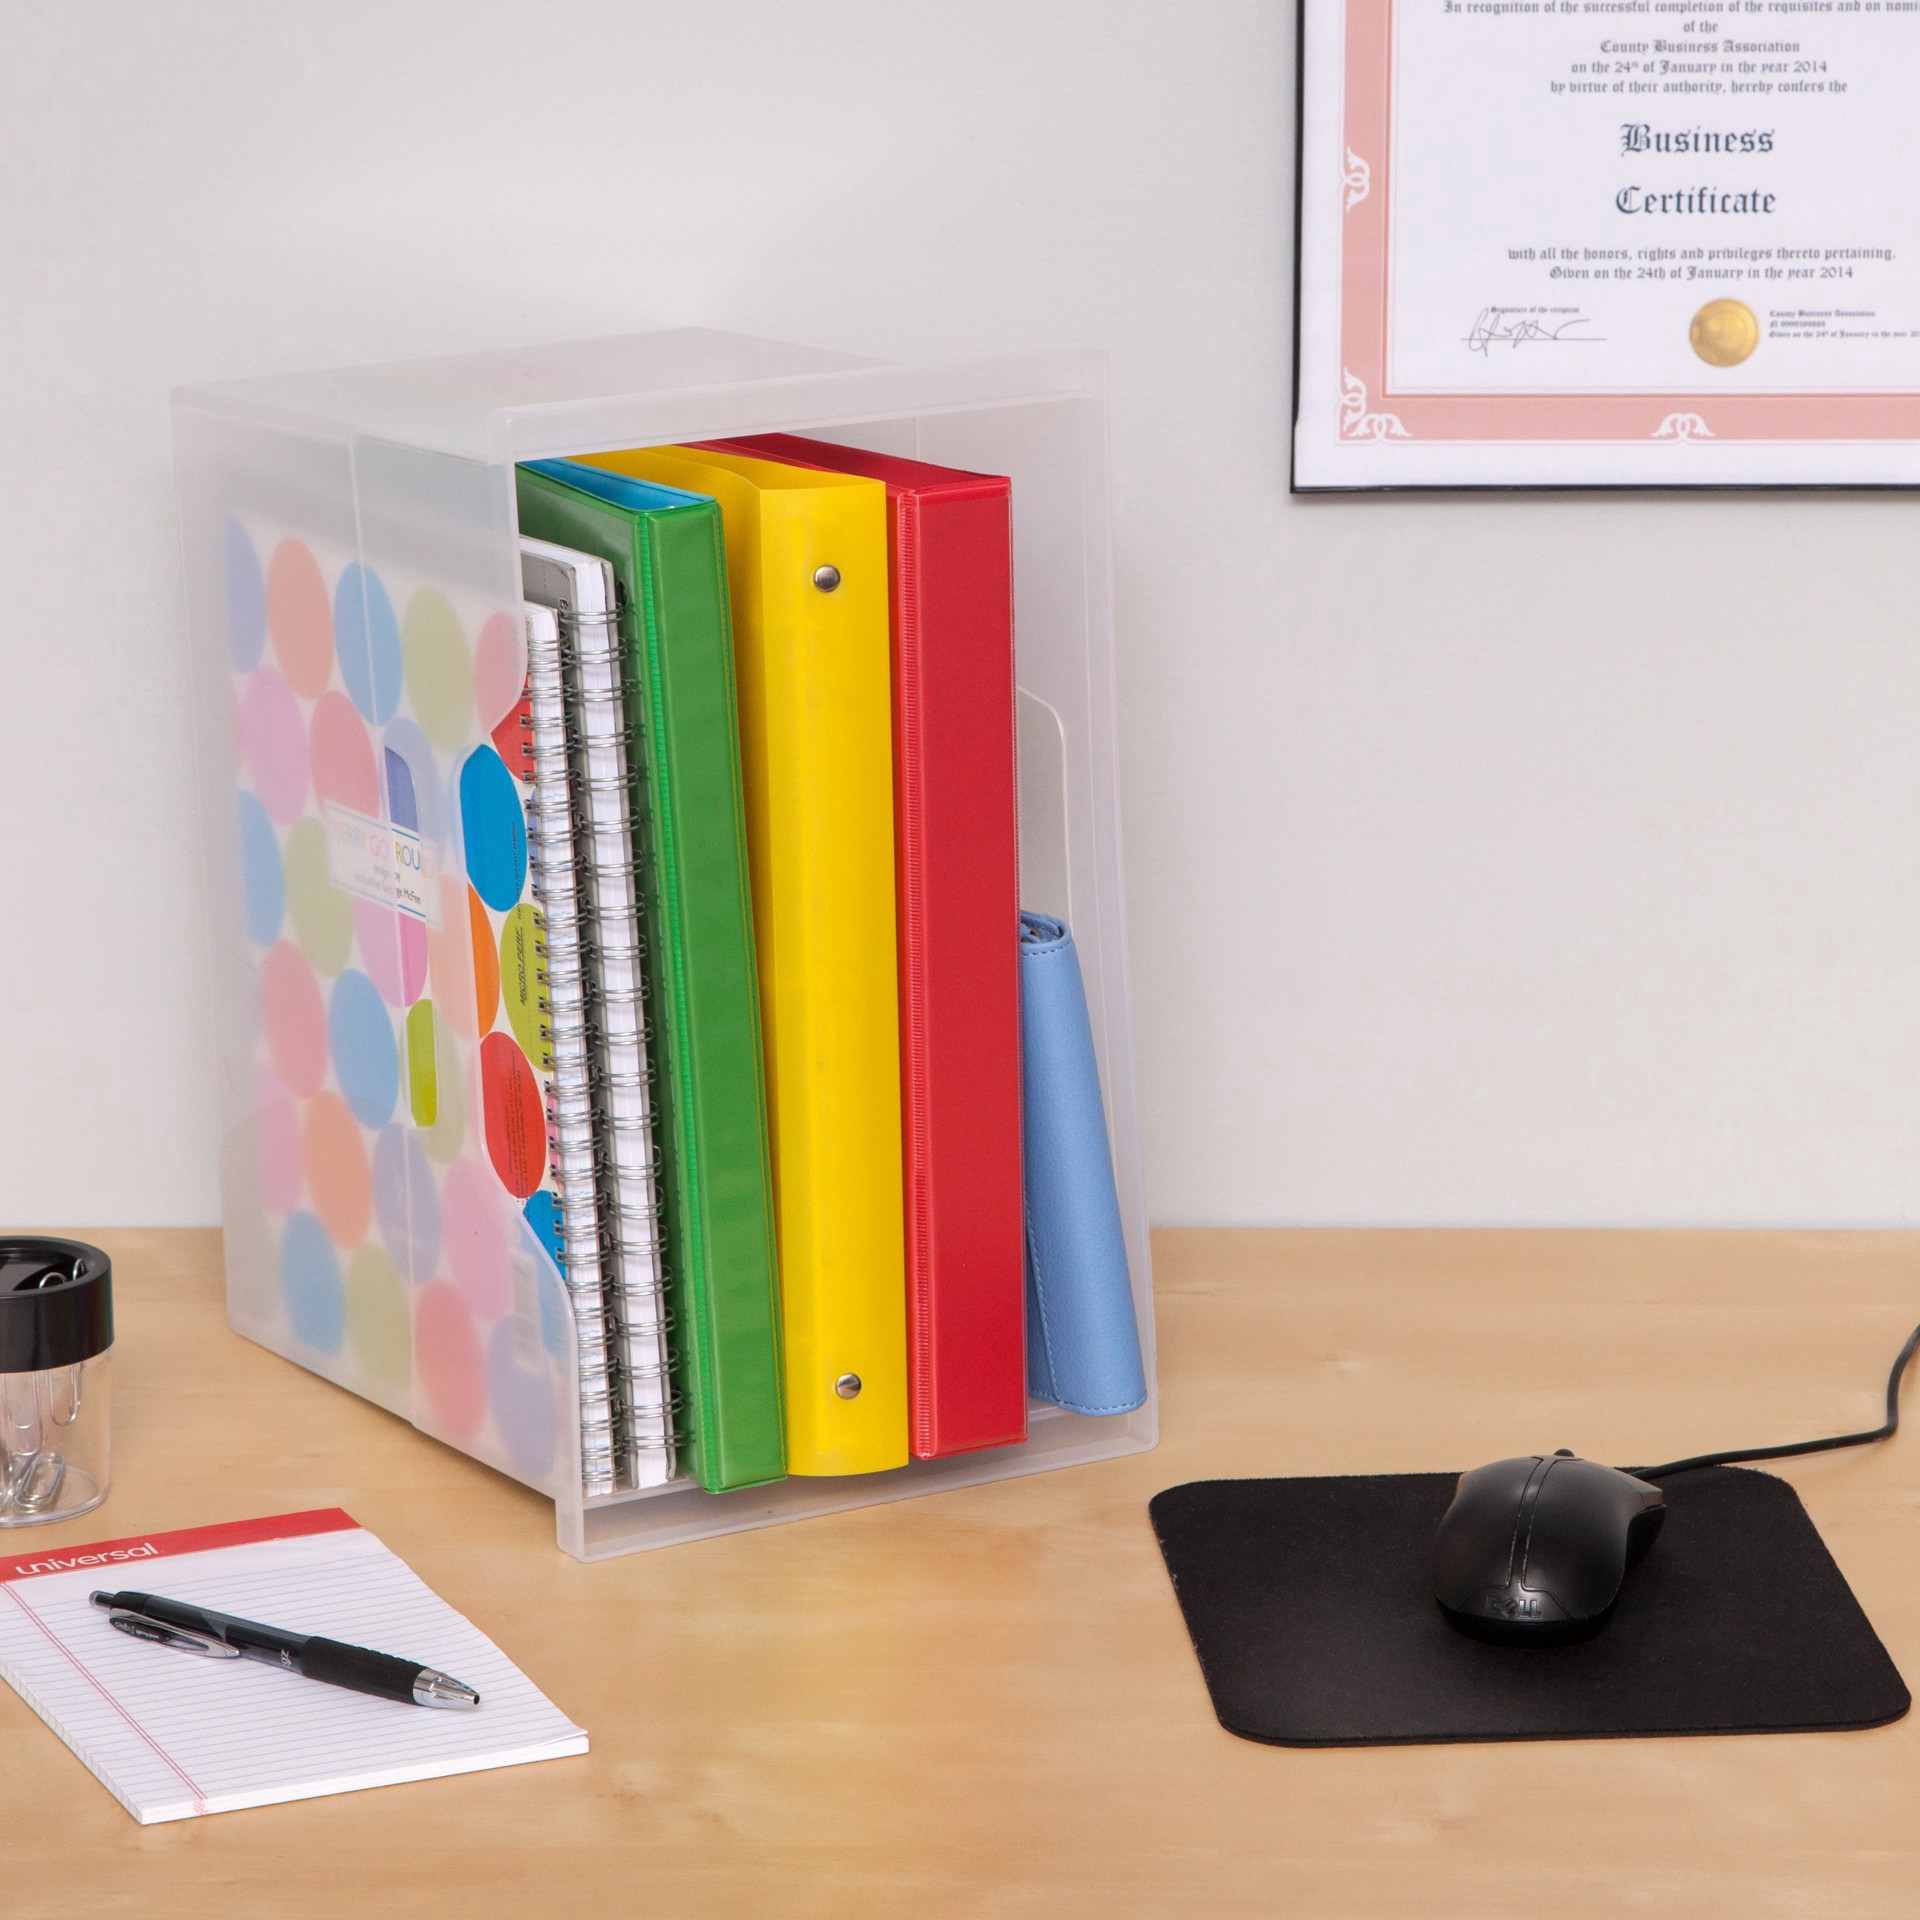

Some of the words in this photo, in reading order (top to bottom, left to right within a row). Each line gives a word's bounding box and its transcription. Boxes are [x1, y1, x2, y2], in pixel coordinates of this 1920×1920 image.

[1443, 0, 1462, 13] In
[1467, 1, 1539, 15] recognition
[1544, 0, 1556, 13] of
[1560, 0, 1579, 14] the
[1583, 0, 1650, 13] successful
[1655, 0, 1723, 14] completion
[1728, 0, 1740, 12] of
[1745, 0, 1763, 14] the
[1768, 1, 1833, 14] requisites
[1837, 0, 1861, 12] and
[1865, 2, 1881, 12] on
[1683, 20, 1695, 33] of
[1700, 20, 1718, 34] the
[1600, 39, 1649, 54] County
[1653, 39, 1718, 53] Business
[1723, 39, 1800, 53] Association
[1571, 64, 1587, 73] on
[1591, 60, 1610, 74] the
[1643, 61, 1655, 73] of
[1660, 60, 1716, 75] January
[1721, 63, 1733, 73] in
[1738, 60, 1756, 74] the
[1761, 63, 1789, 74] year
[1794, 60, 1827, 73] 2014
[1550, 80, 1565, 95] by
[1569, 81, 1608, 93] virtue
[1612, 80, 1624, 93] of
[1629, 80, 1659, 94] their
[1663, 80, 1726, 95] authority,
[1731, 80, 1773, 95] hereby
[1778, 80, 1825, 92] confers
[1829, 80, 1848, 94] the
[1620, 124, 1775, 157] Business
[1615, 185, 1776, 214] Certificate
[1508, 247, 1536, 261] with
[1539, 247, 1556, 260] all
[1561, 248, 1579, 261] the
[1638, 247, 1676, 262] rights
[1680, 247, 1704, 259] and
[1708, 247, 1773, 262] privileges
[1777, 247, 1820, 260] thereto
[1549, 266, 1589, 279] Given
[1594, 269, 1609, 279] on
[1614, 267, 1633, 280] the
[1637, 266, 1666, 280] 24th
[1670, 266, 1682, 279] of
[1686, 265, 1743, 281] January
[1748, 267, 1760, 279] in
[1765, 266, 1783, 280] the
[1788, 268, 1815, 280] year
[1820, 266, 1853, 278] 2014
[515, 925, 524, 962] PERF
[517, 963, 526, 1007] MICRO
[16, 1543, 159, 1575] universal
